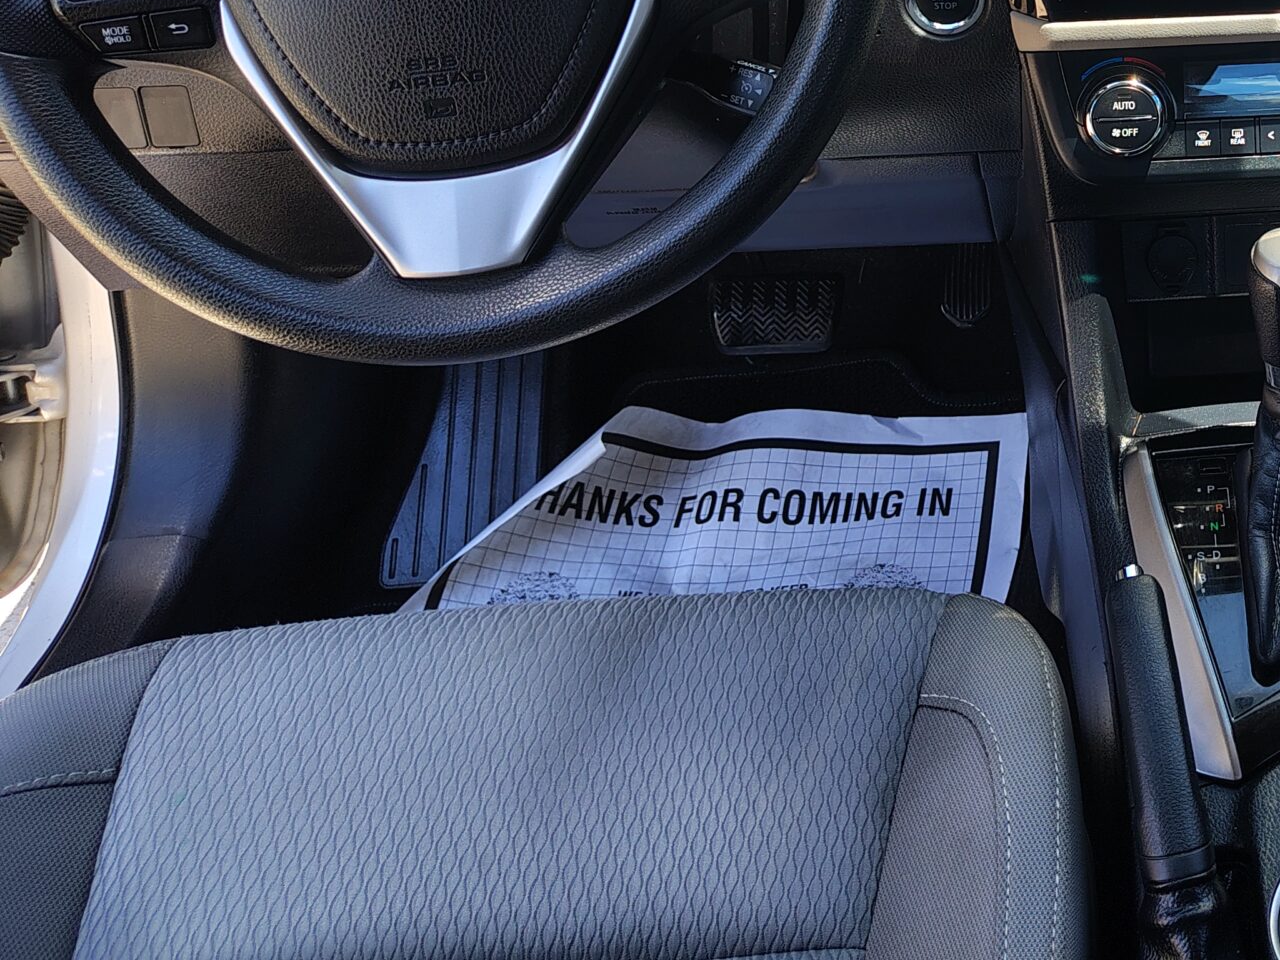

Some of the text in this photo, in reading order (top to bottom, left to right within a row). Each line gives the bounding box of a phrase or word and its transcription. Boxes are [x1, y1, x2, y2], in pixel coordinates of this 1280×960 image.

[934, 2, 958, 10] STOP
[102, 26, 130, 36] MODE
[112, 35, 131, 43] HOLD
[737, 59, 767, 72] CANCEL
[738, 68, 754, 78] RES
[389, 68, 488, 93] AIRBAG
[730, 94, 746, 105] SET
[1112, 101, 1136, 111] AUTO
[1122, 128, 1139, 137] OFF
[1207, 485, 1215, 494] P
[535, 481, 953, 528] HANKS FOR COMING IN
[1215, 503, 1223, 513] R
[1210, 522, 1219, 531] N
